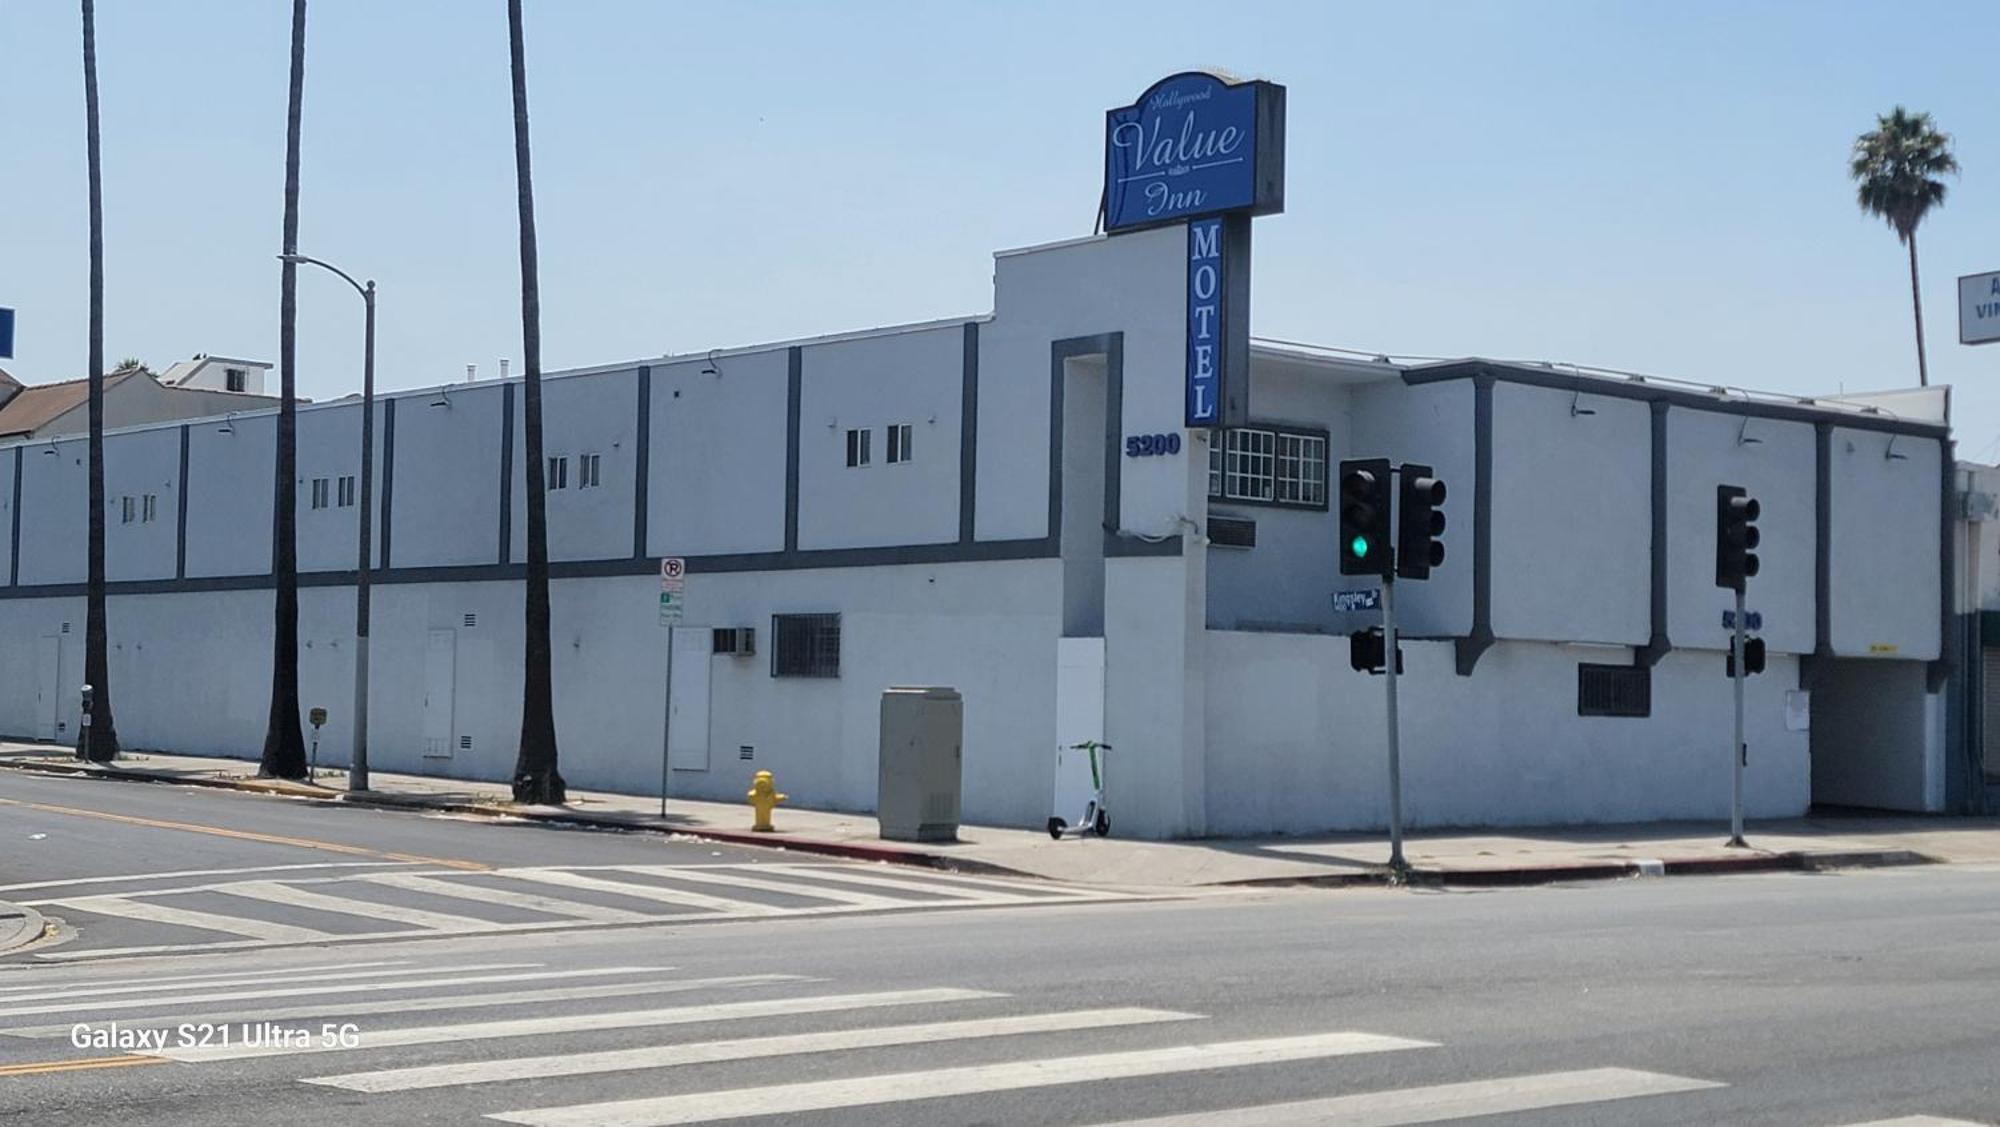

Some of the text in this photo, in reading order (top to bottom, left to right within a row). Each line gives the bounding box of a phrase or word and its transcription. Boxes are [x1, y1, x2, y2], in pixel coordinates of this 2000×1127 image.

[1150, 85, 1212, 110] Hollywood
[1112, 110, 1246, 171] Value
[1145, 181, 1208, 216] Inn
[1191, 224, 1219, 419] MOTEL
[1126, 433, 1181, 458] 5200
